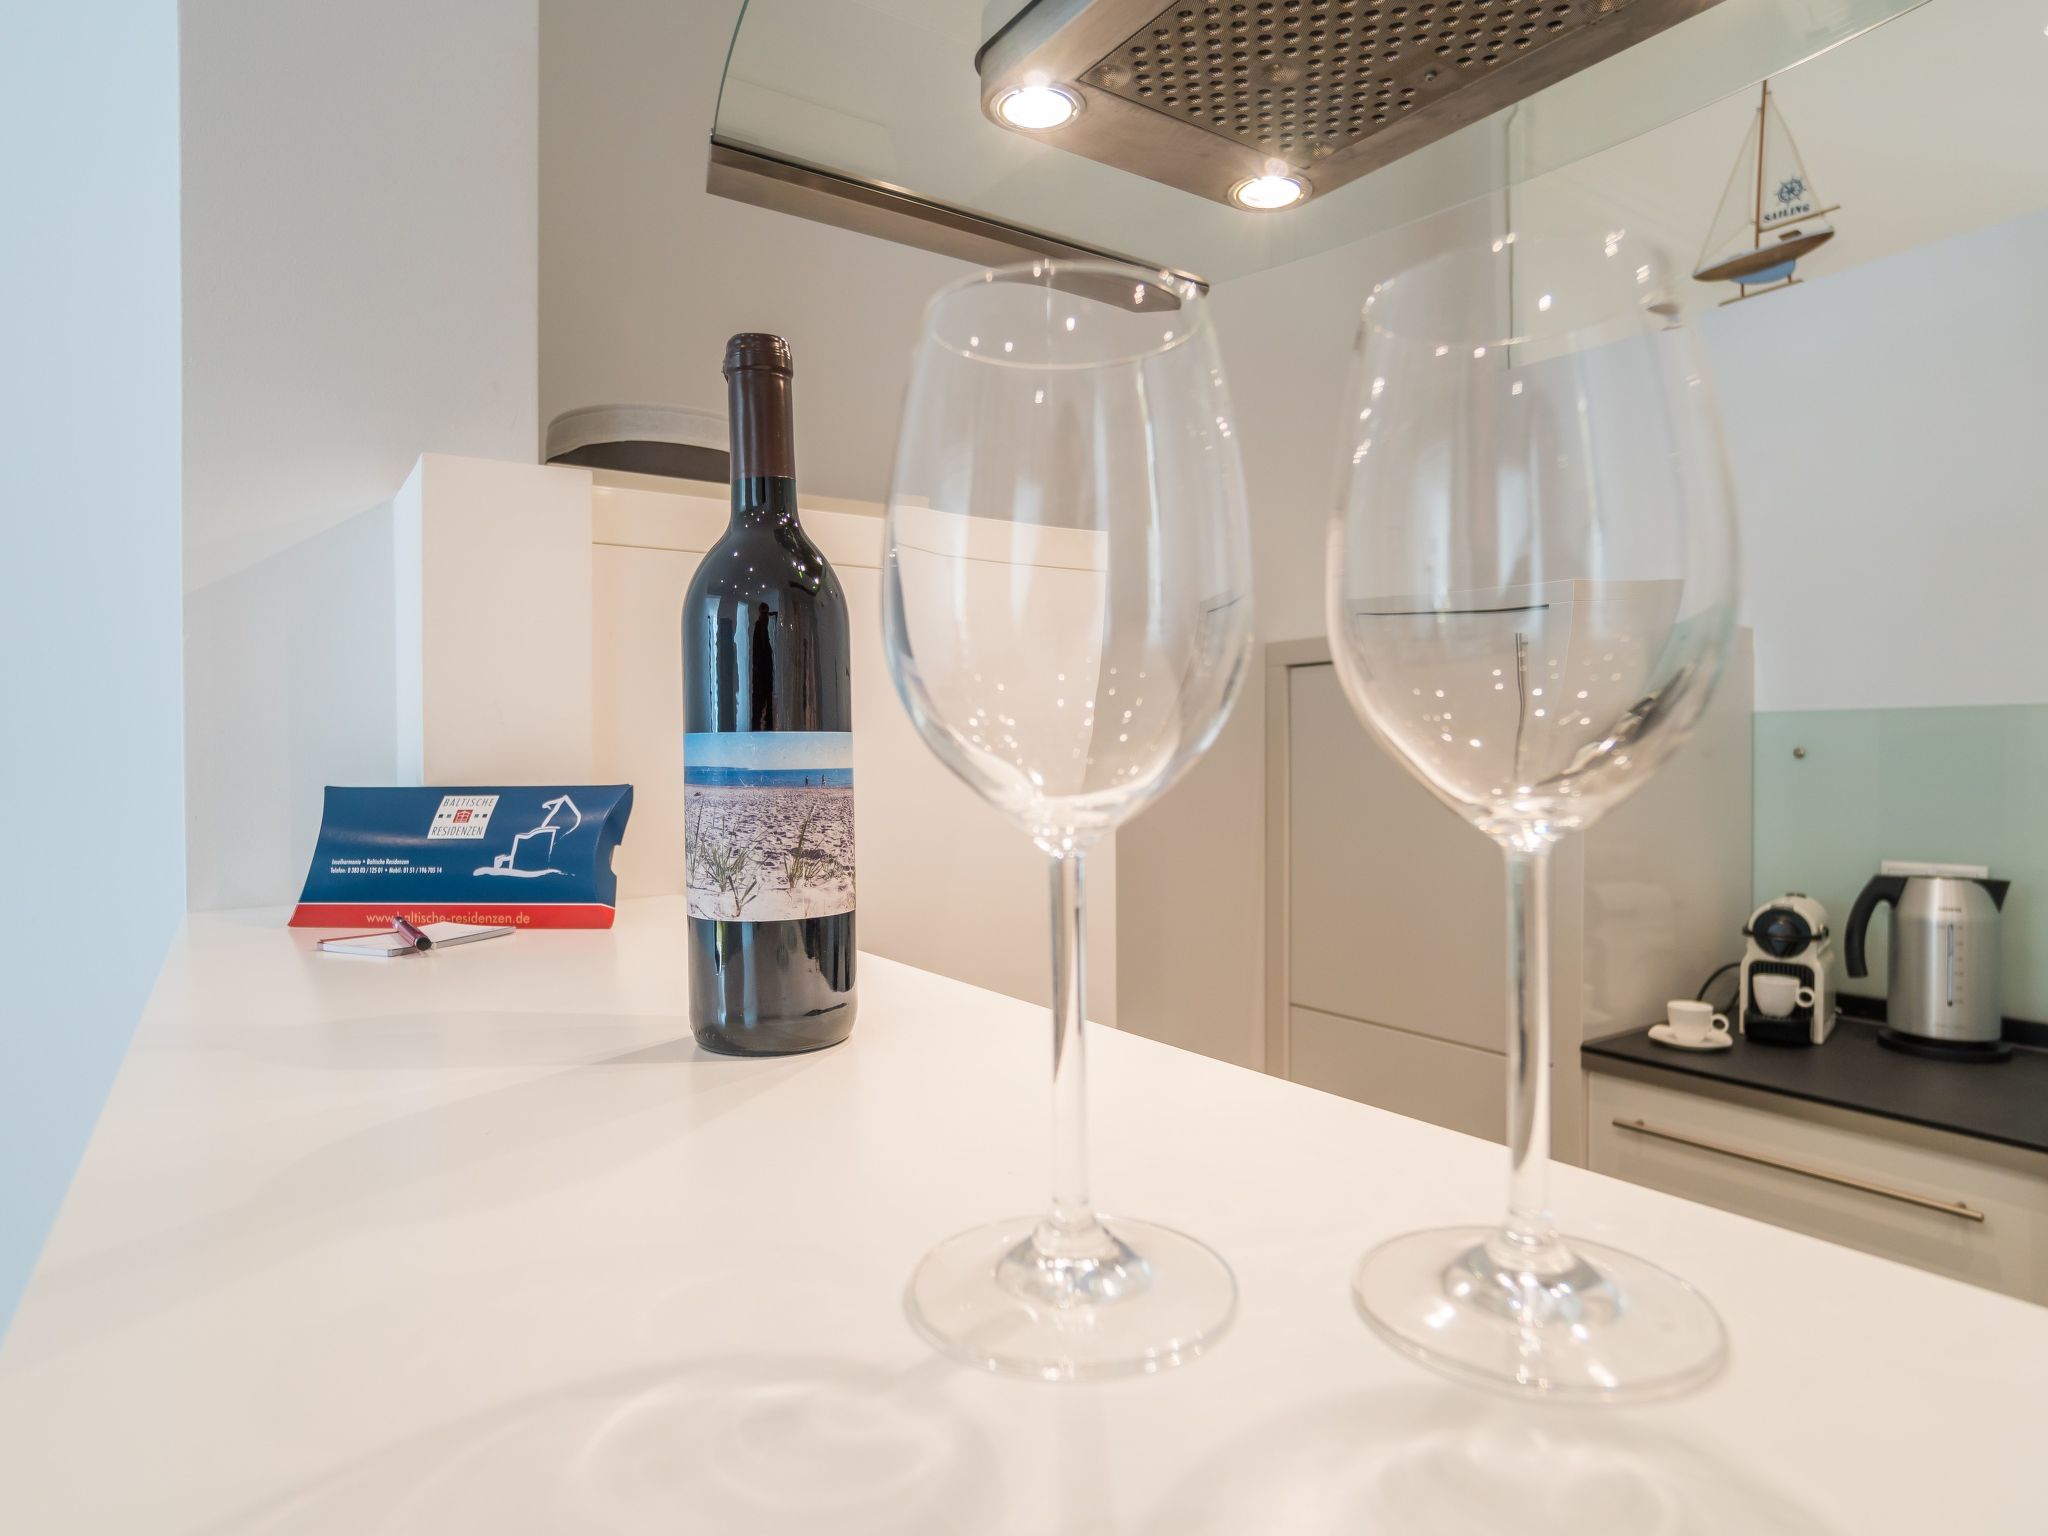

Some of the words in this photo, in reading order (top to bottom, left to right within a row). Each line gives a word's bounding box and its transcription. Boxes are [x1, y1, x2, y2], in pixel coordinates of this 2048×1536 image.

[1763, 203, 1810, 222] SAILING
[443, 797, 495, 807] BALTISCHE
[431, 826, 484, 837] RESIDENZEN
[366, 911, 531, 924] wwwaltische-residenzen.de
